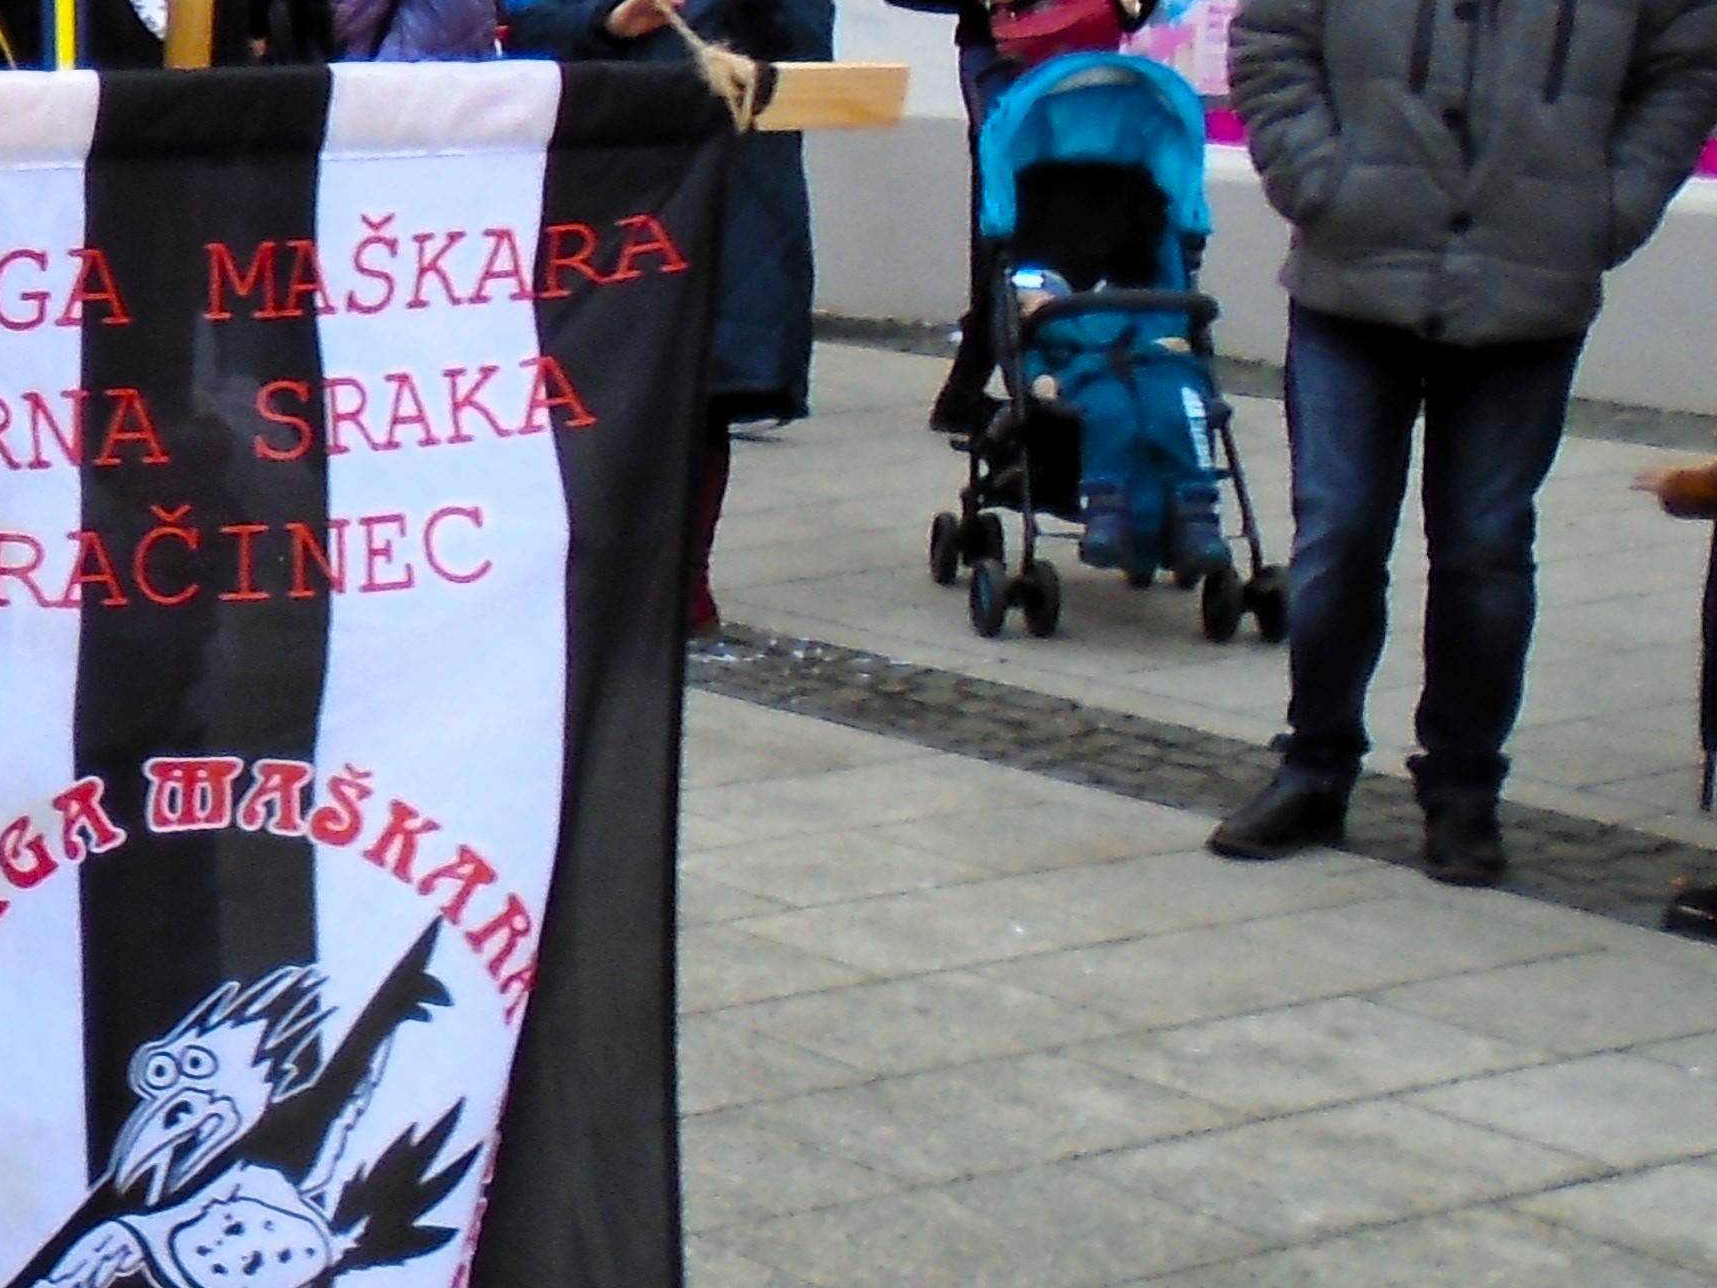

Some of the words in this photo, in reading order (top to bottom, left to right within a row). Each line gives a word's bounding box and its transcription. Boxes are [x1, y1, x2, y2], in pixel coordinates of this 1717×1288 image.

[202, 211, 691, 324] MAŠKARA
[253, 353, 596, 462] SRAKA
[143, 756, 538, 1027] MAŠKARA
